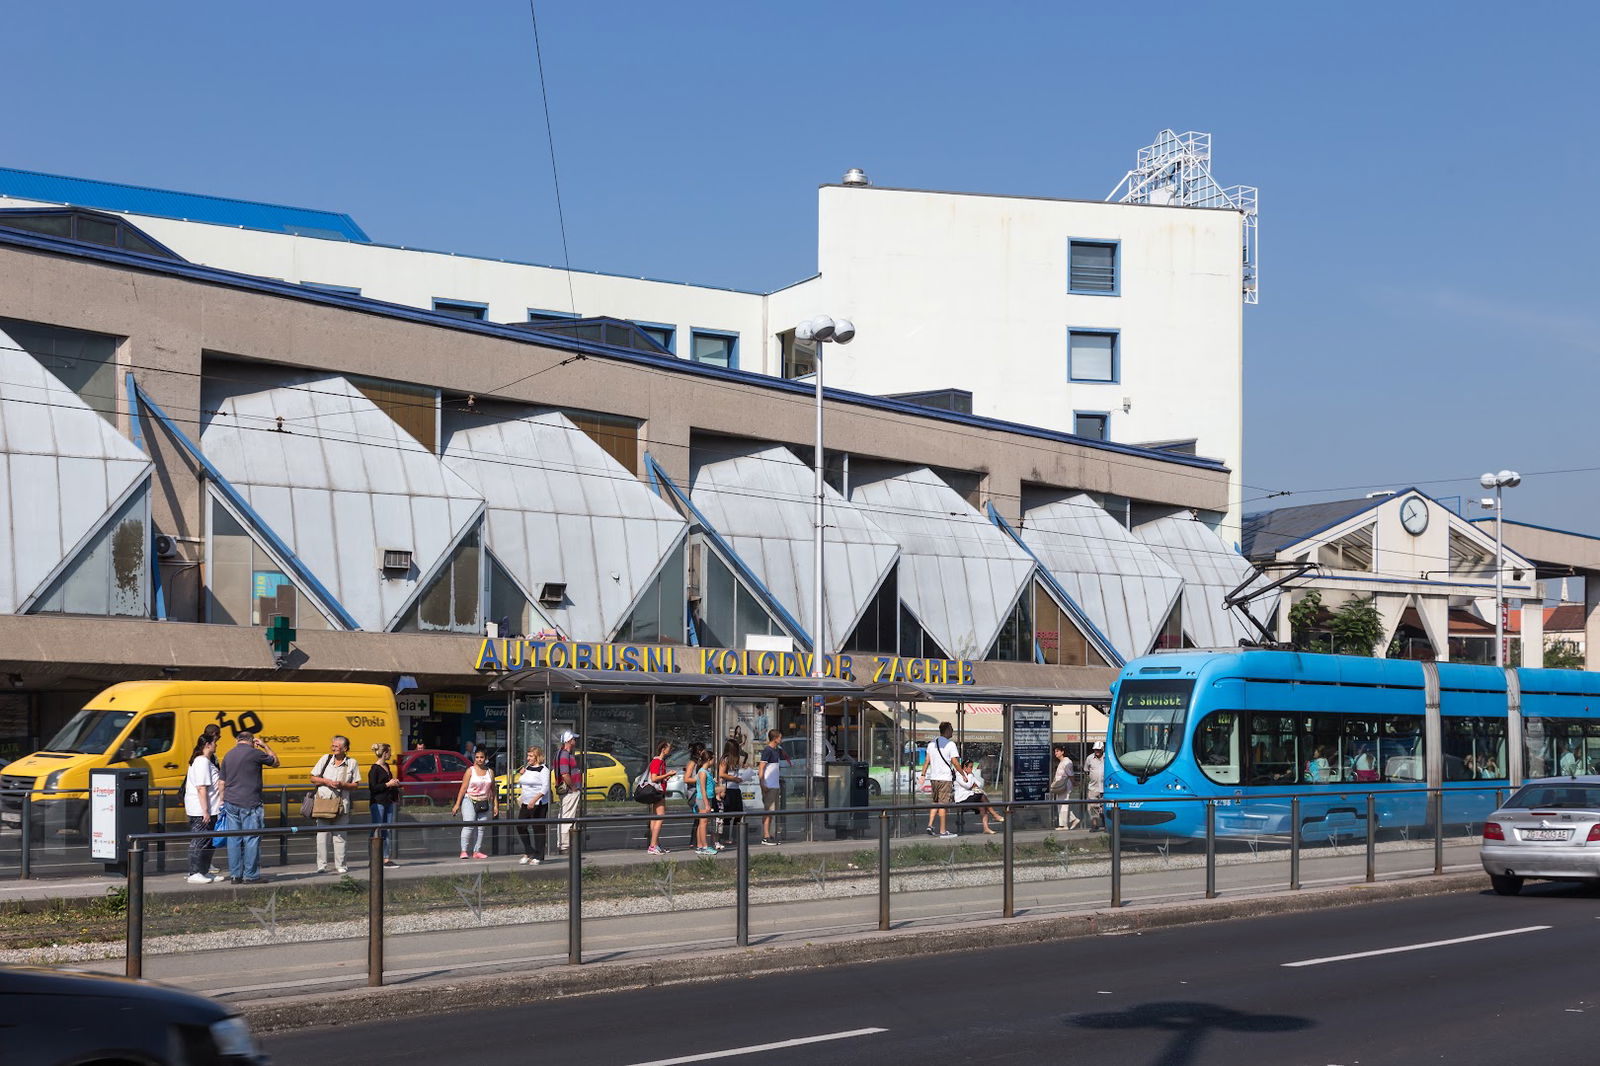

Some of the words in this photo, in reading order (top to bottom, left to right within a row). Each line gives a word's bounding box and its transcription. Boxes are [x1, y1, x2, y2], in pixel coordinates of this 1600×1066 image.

[475, 639, 675, 673] AUTOBUSNI
[873, 657, 974, 685] ZAGREB
[396, 699, 416, 711] cia
